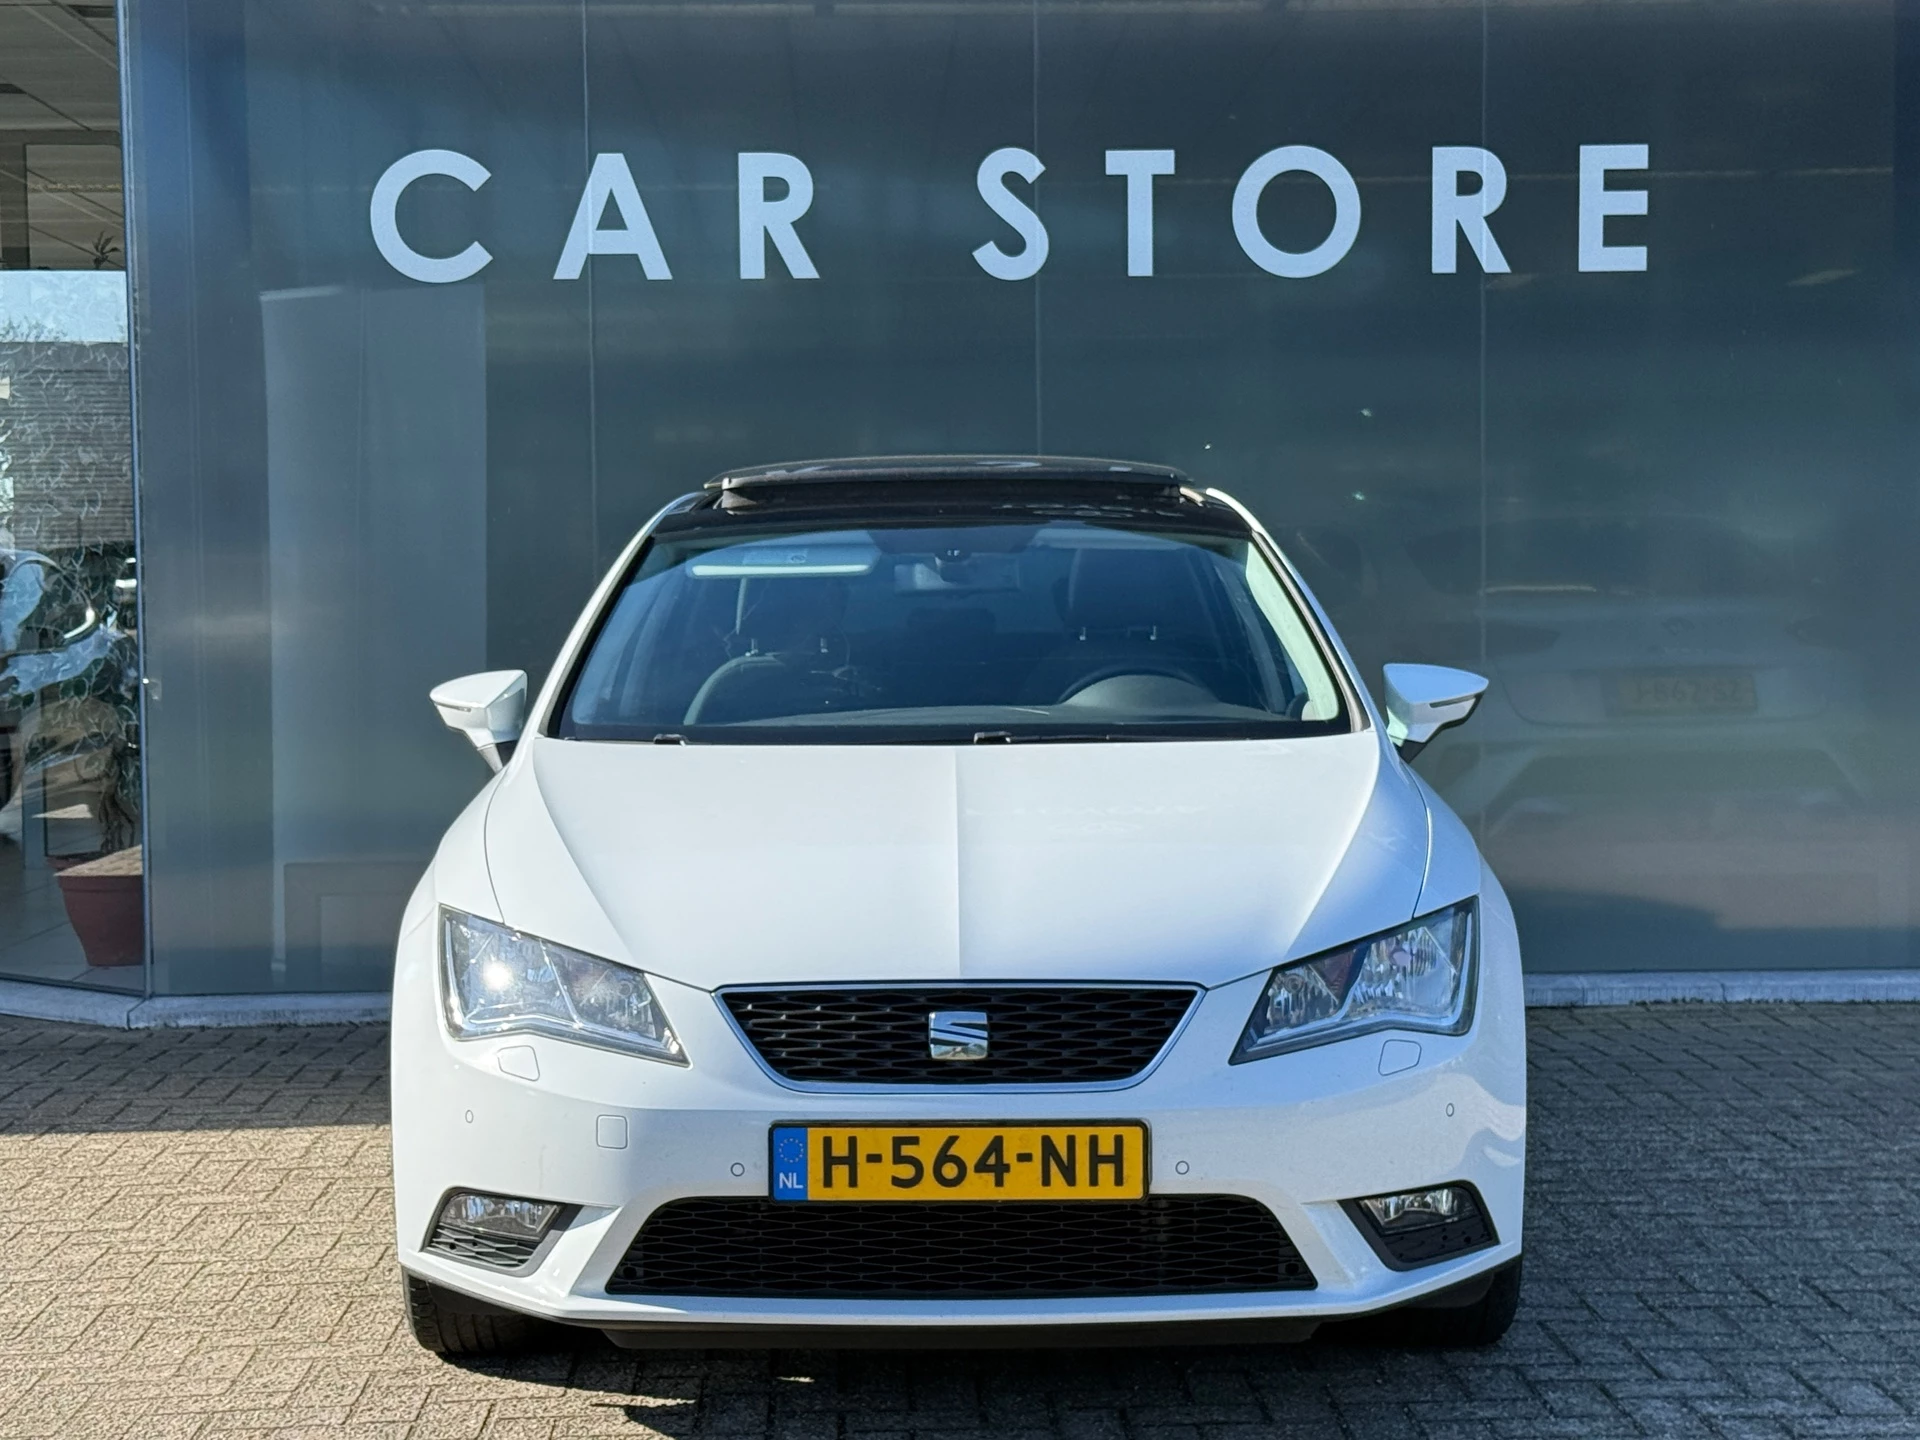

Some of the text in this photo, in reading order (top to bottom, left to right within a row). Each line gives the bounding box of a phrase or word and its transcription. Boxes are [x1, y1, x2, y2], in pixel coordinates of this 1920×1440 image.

[370, 144, 1649, 283] CAR STORE
[779, 1172, 804, 1189] NL
[822, 1133, 1125, 1189] H-564-NH
